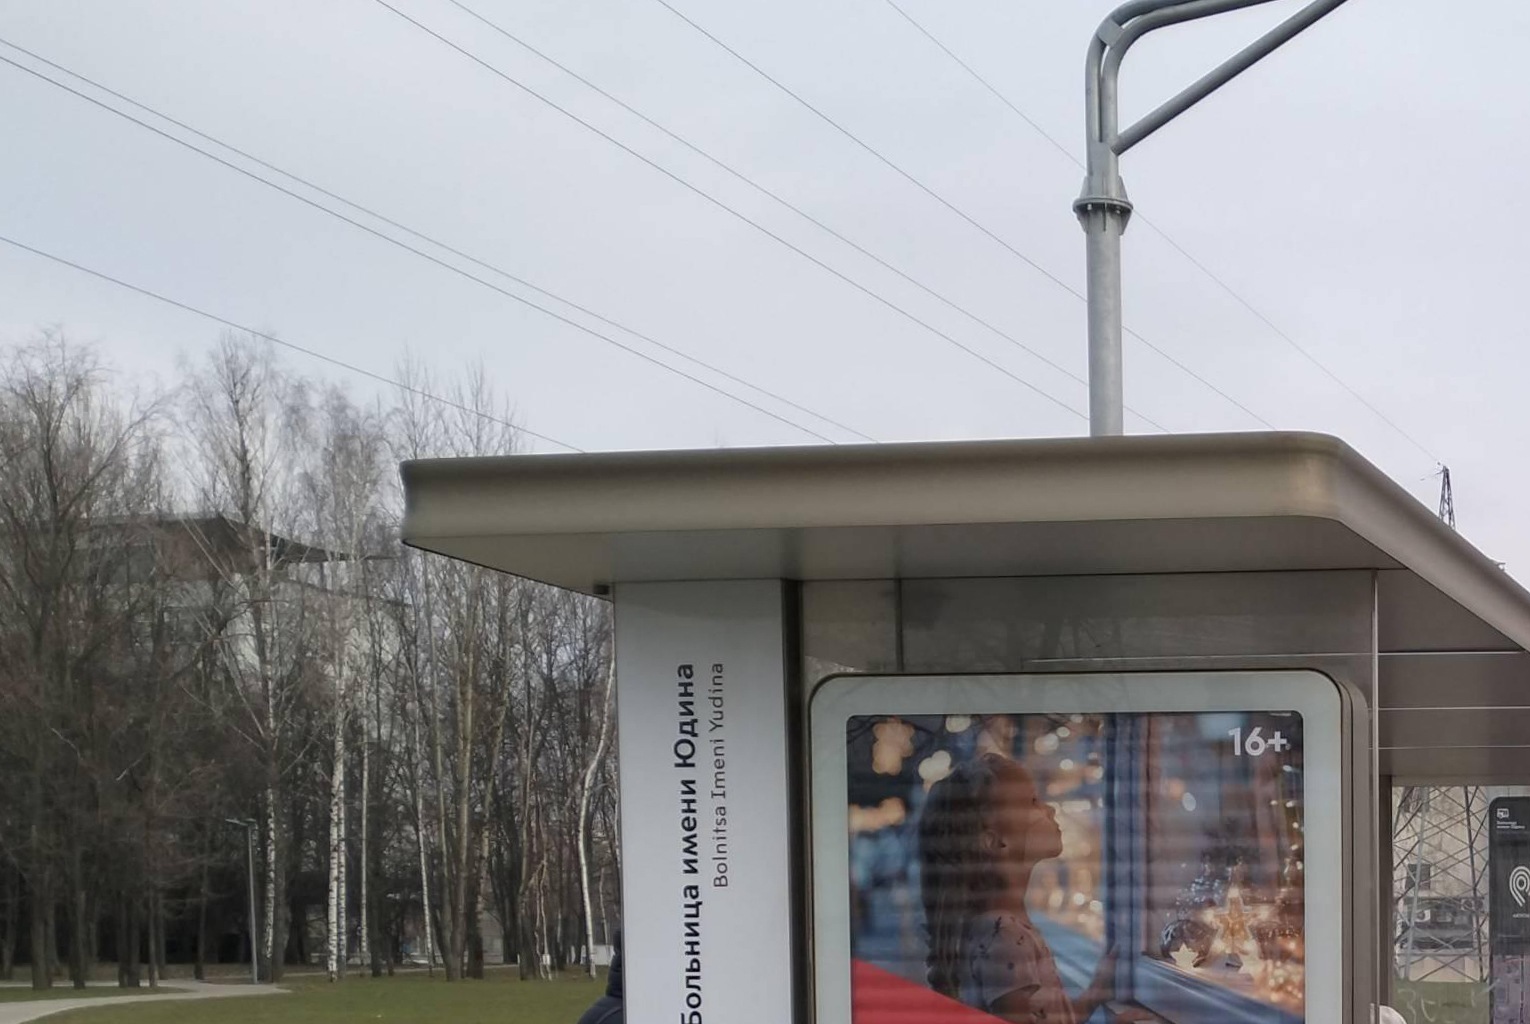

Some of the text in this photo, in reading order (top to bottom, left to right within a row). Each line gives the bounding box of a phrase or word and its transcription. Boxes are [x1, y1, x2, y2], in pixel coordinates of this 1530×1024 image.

[673, 664, 699, 768] Юдина
[1227, 726, 1288, 757] 16+
[707, 663, 728, 888] Bolnitsa Imeni Yudina
[680, 779, 699, 875] имени
